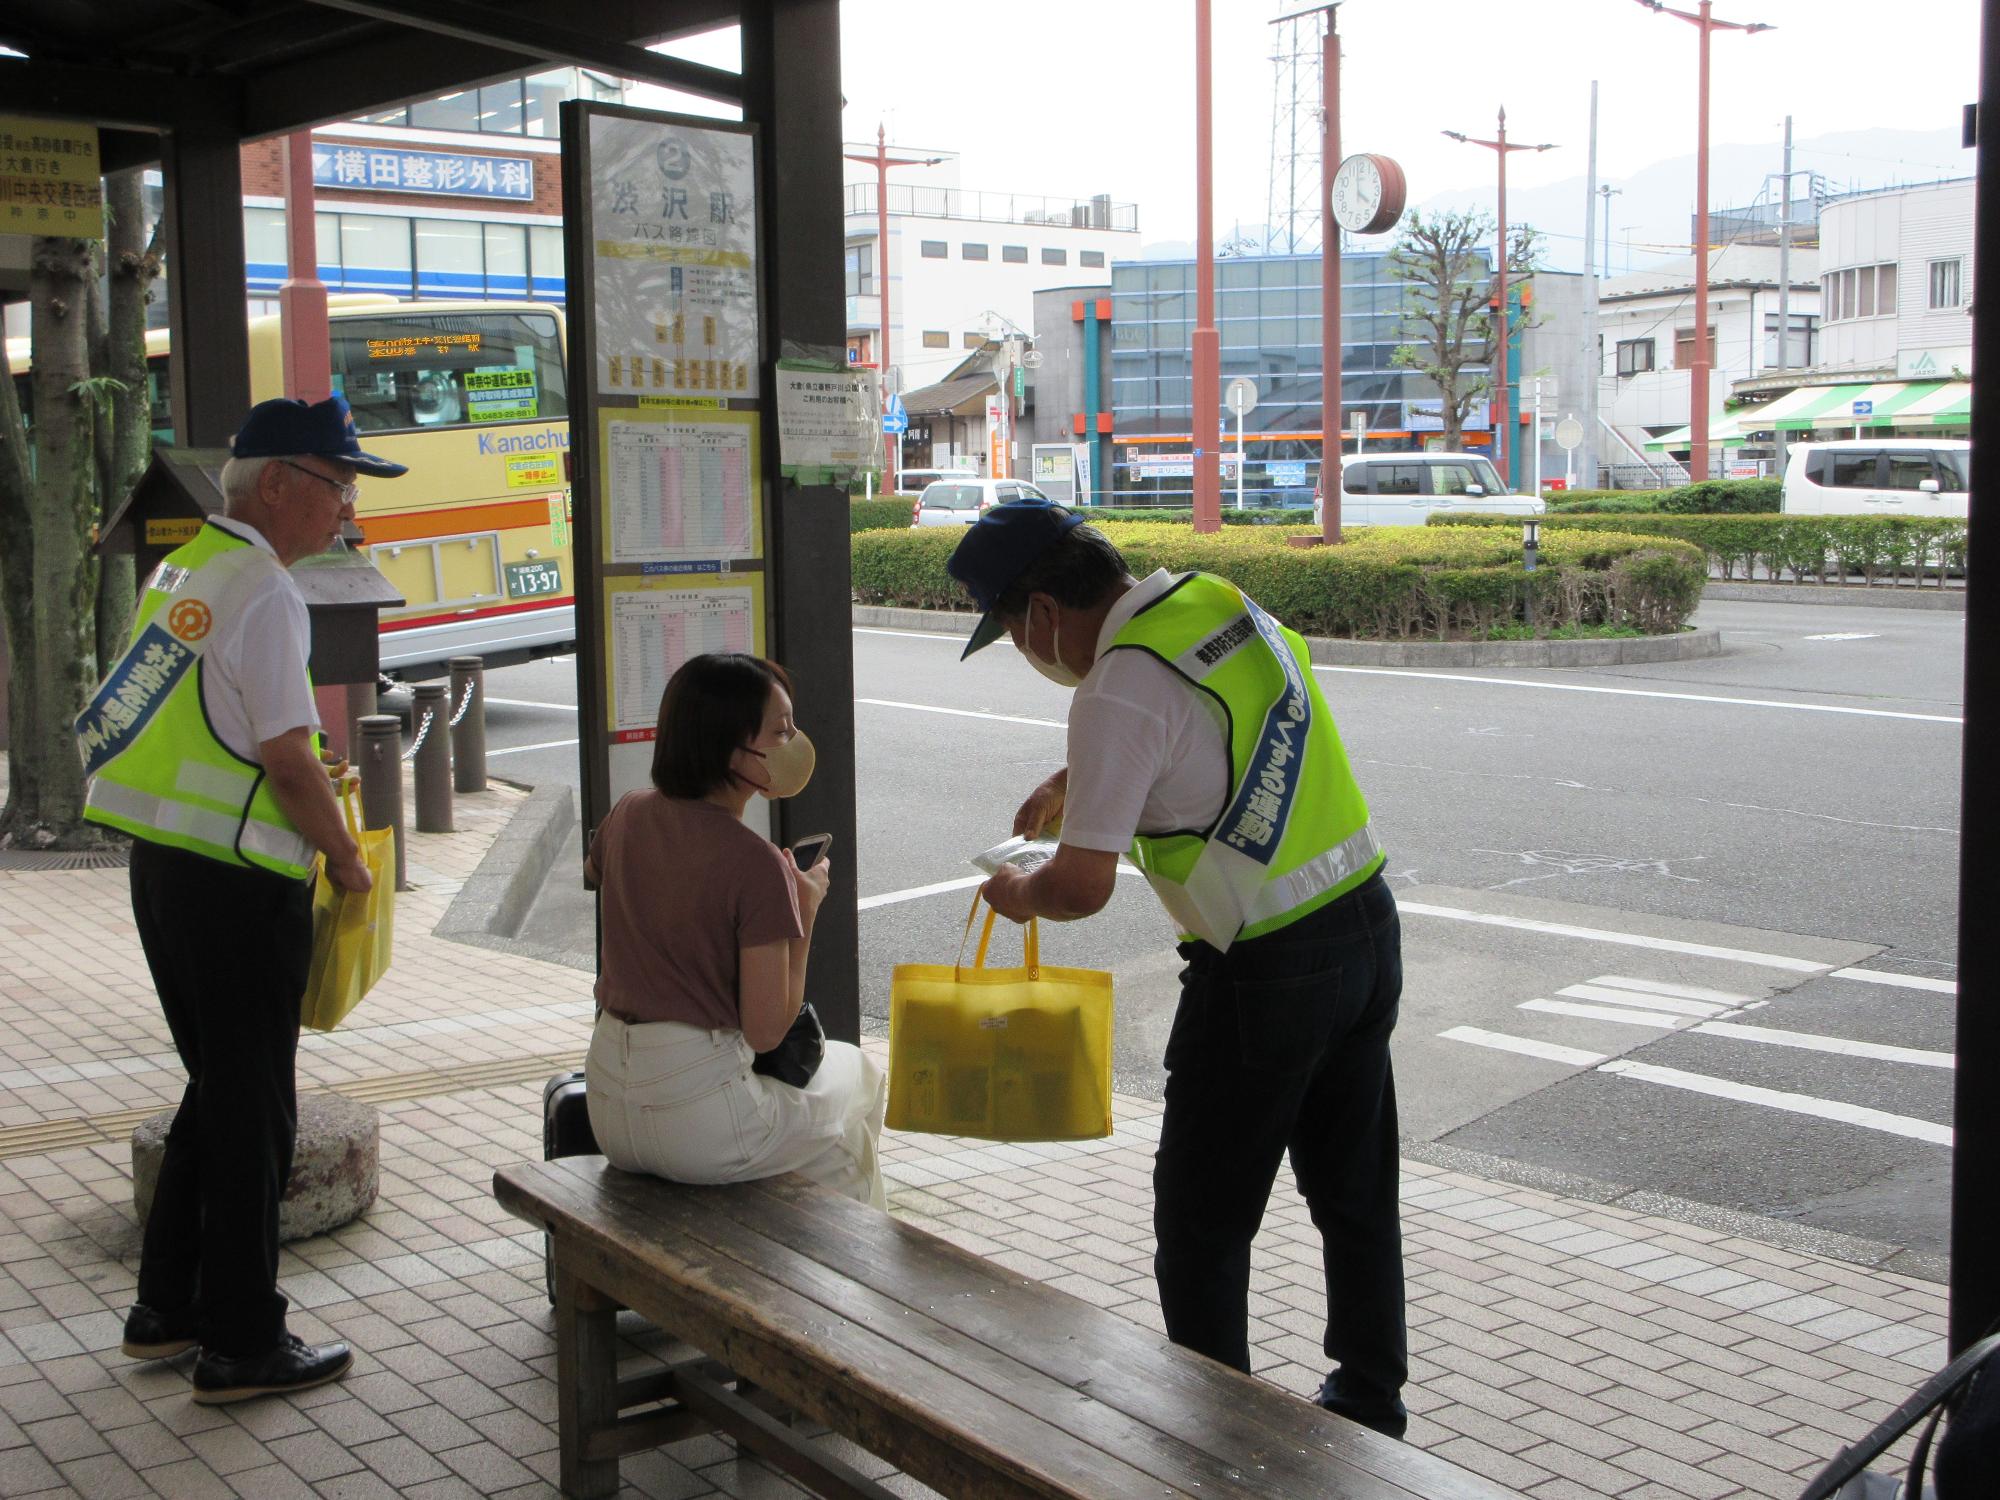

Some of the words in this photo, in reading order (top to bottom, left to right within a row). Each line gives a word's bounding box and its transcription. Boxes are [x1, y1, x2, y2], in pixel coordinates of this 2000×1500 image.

[335, 150, 529, 195] 横田整形外科
[519, 570, 559, 594] 13-97
